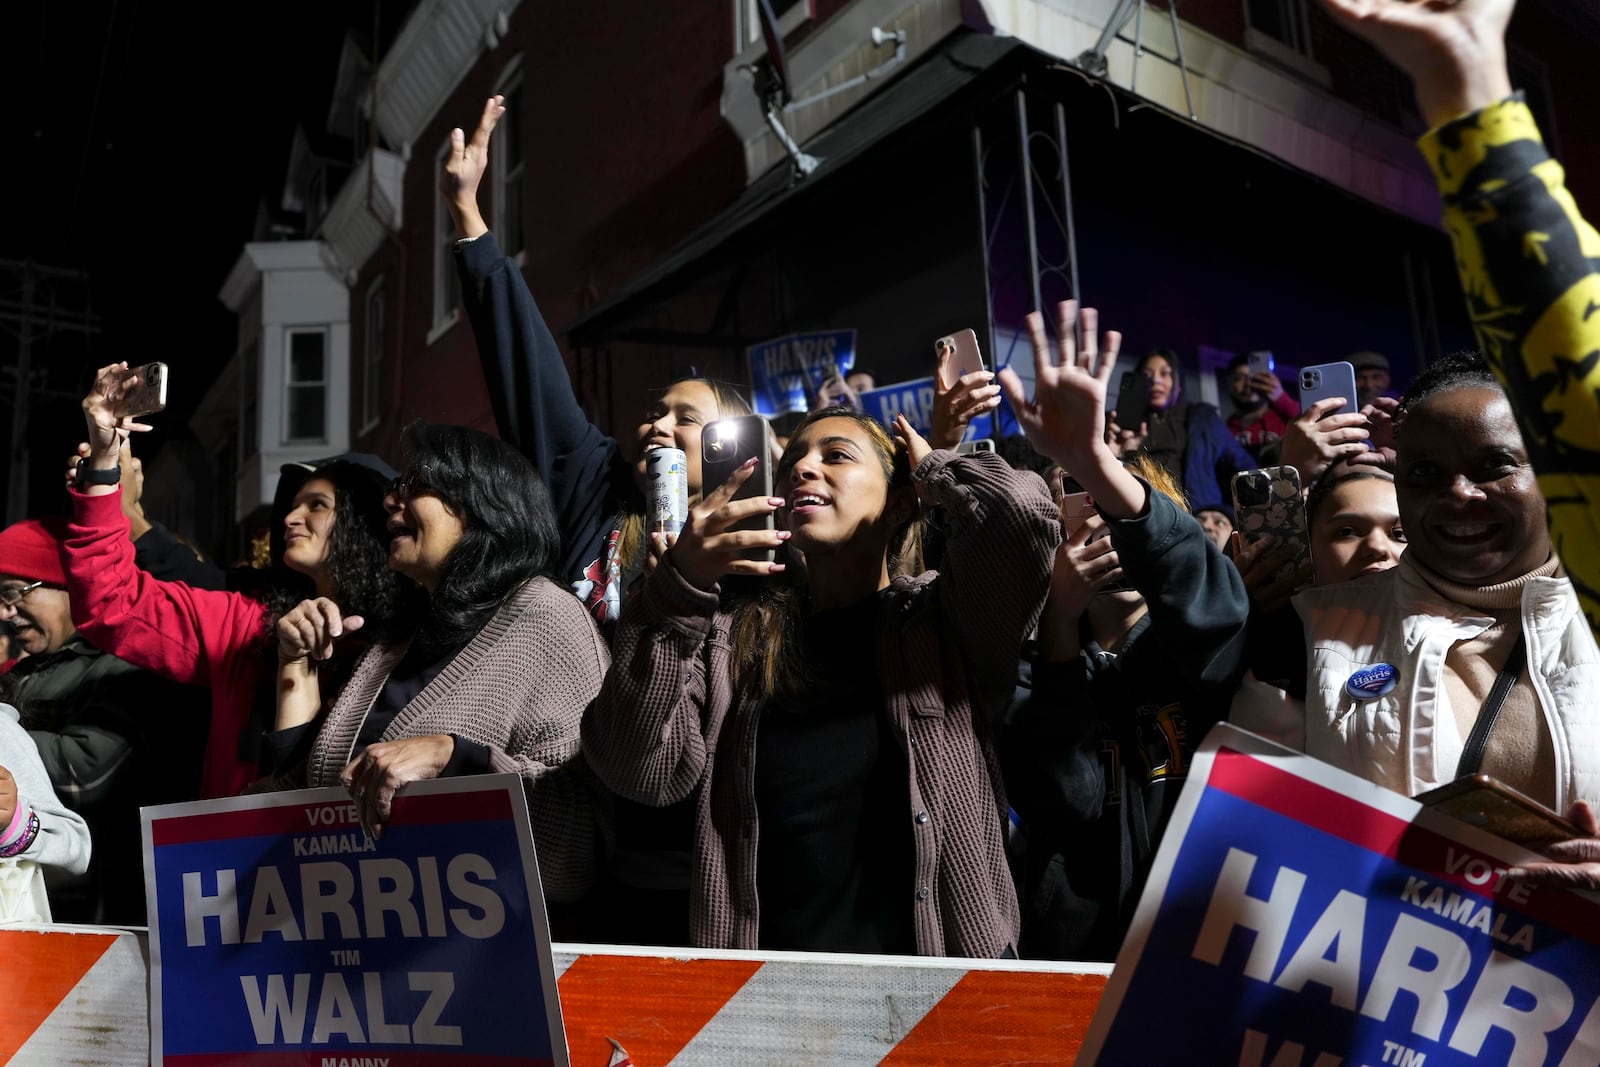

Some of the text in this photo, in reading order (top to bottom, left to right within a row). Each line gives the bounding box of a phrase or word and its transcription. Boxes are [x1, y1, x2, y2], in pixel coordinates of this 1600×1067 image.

[1353, 671, 1391, 687] Harris
[304, 804, 361, 827] VOTE
[292, 833, 377, 857] KAMALA
[1443, 846, 1538, 905] VOTE
[182, 852, 506, 948] HARRIS
[1399, 876, 1536, 953] KAMALA
[330, 949, 361, 967] TIM
[239, 971, 464, 1047] WALZ
[1381, 1040, 1427, 1067] TIM
